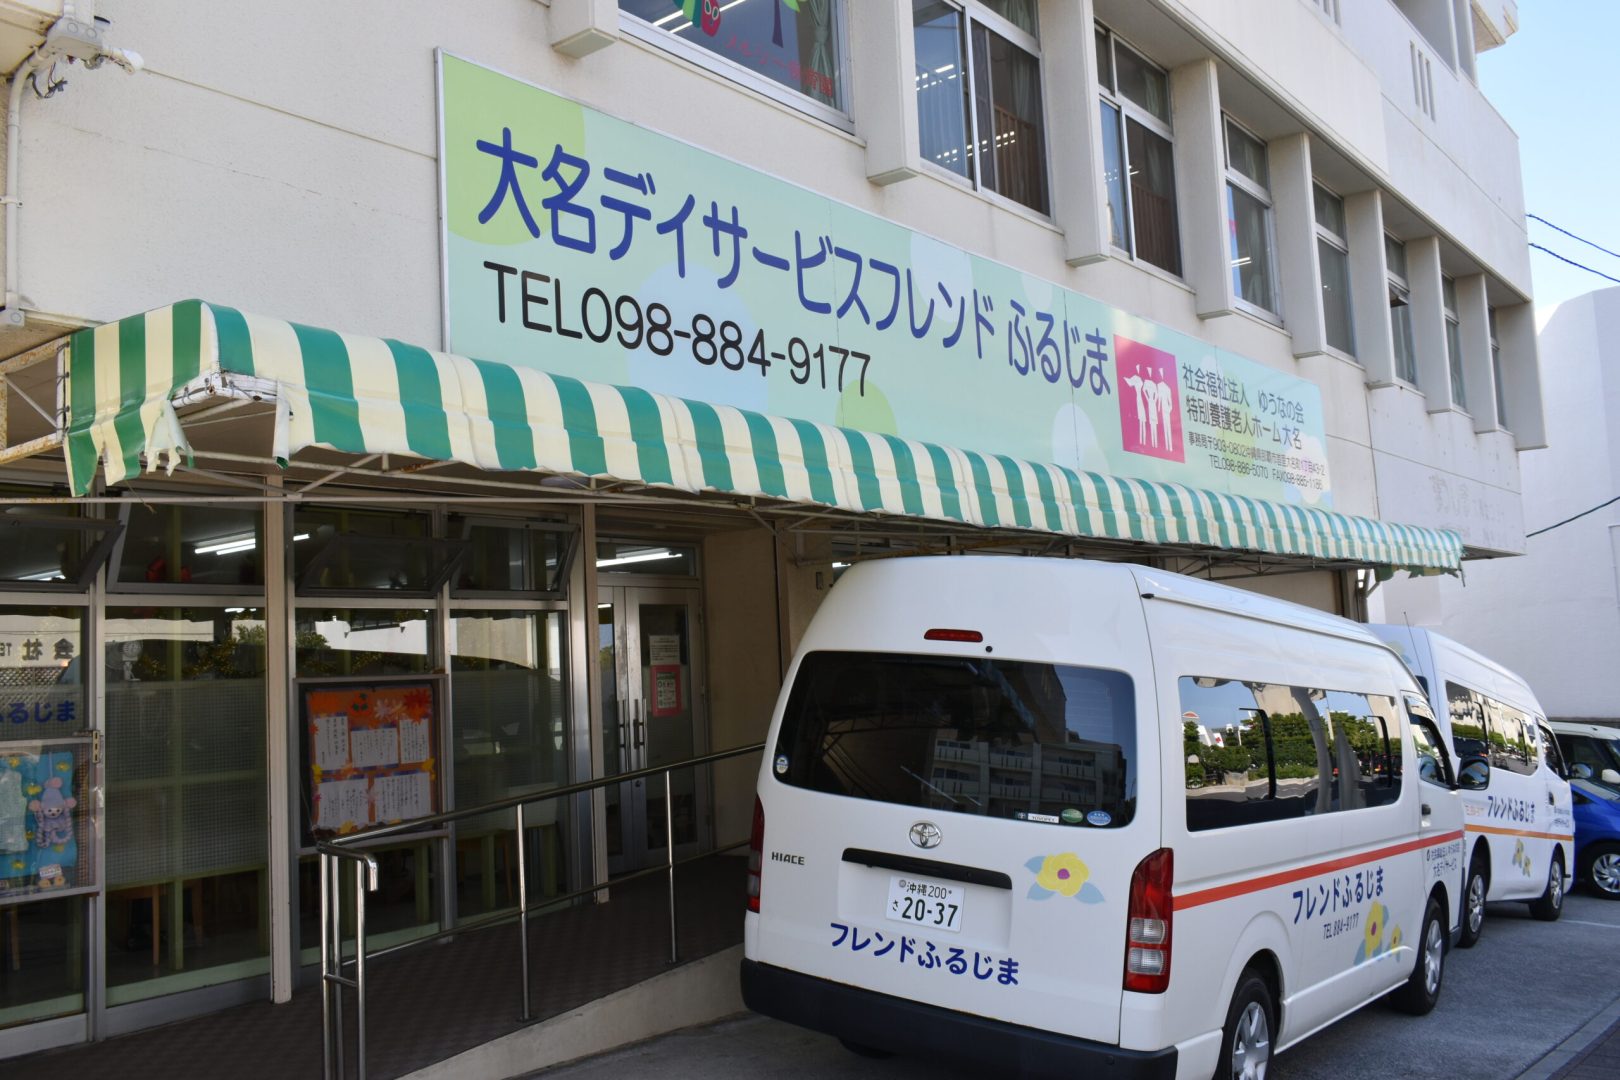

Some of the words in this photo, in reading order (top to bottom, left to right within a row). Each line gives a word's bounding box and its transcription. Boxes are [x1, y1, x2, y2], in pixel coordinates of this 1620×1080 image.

[1009, 299, 1111, 396] ふるじま
[1182, 362, 1250, 407] 社会福祉法人
[1258, 389, 1304, 424] ゆうなの会
[1186, 395, 1302, 450] 特別養護老人ホーム大名
[0, 701, 76, 724] るじま
[771, 851, 805, 865] HIACE
[902, 896, 958, 927] 20-37
[1292, 865, 1384, 925] フレンドふるじま
[830, 922, 1019, 986] フレンドふるじま
